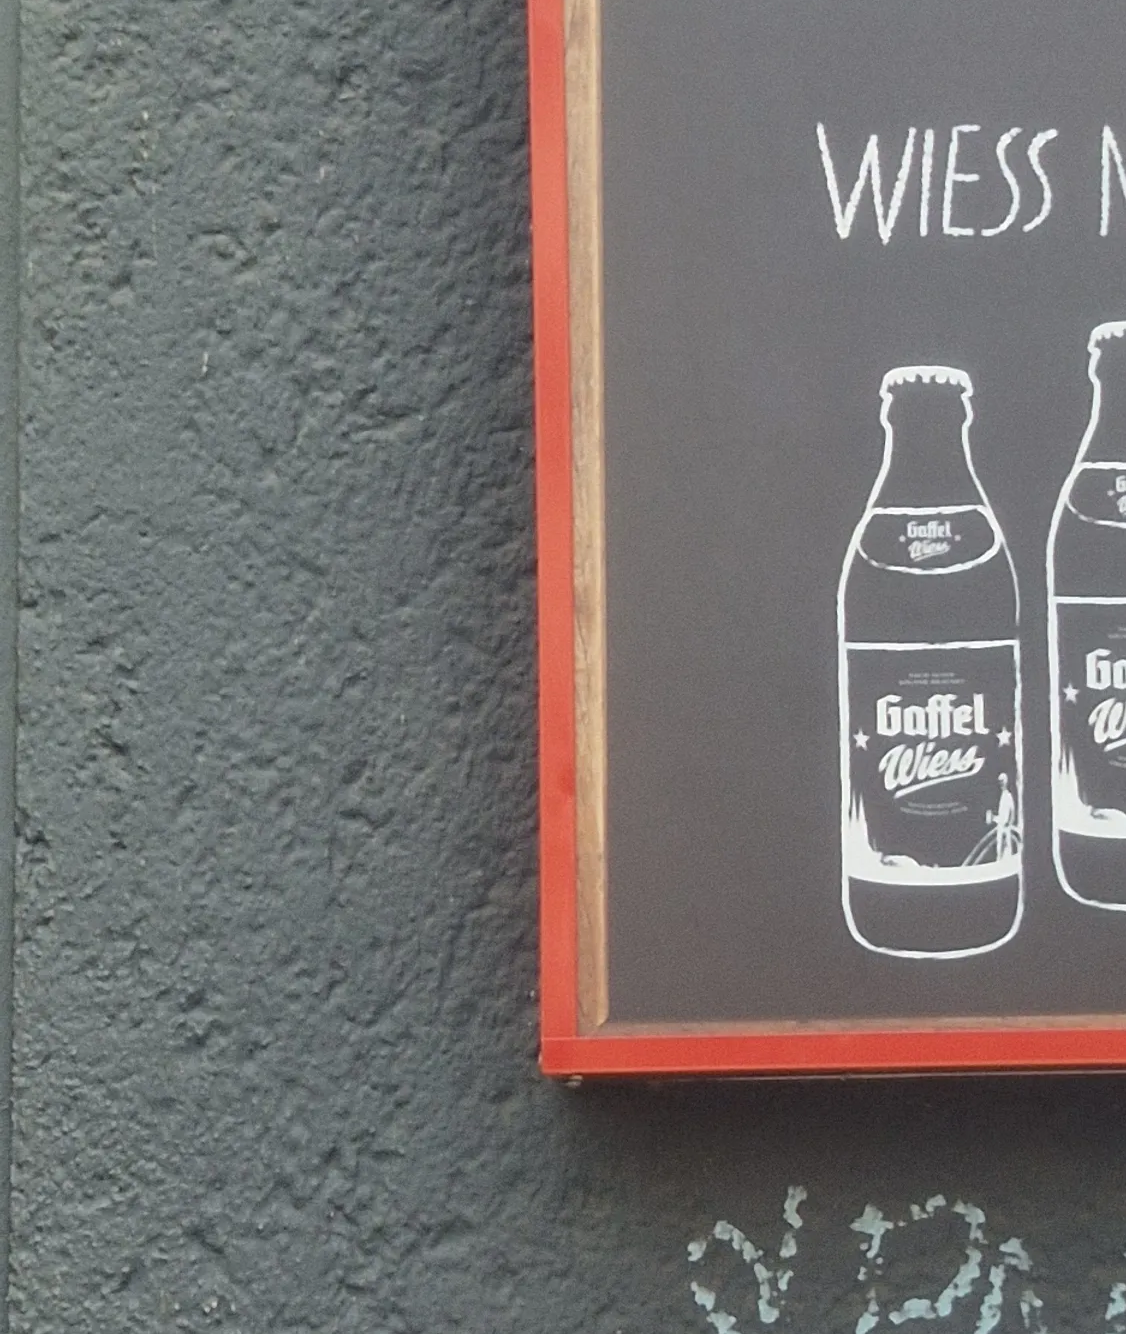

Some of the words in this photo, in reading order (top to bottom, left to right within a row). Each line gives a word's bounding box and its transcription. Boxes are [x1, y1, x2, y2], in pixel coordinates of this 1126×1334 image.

[817, 122, 1059, 244] WIESS
[906, 520, 952, 539] Gaffel
[876, 693, 990, 740] Gaffel
[878, 740, 986, 799] Wiess
